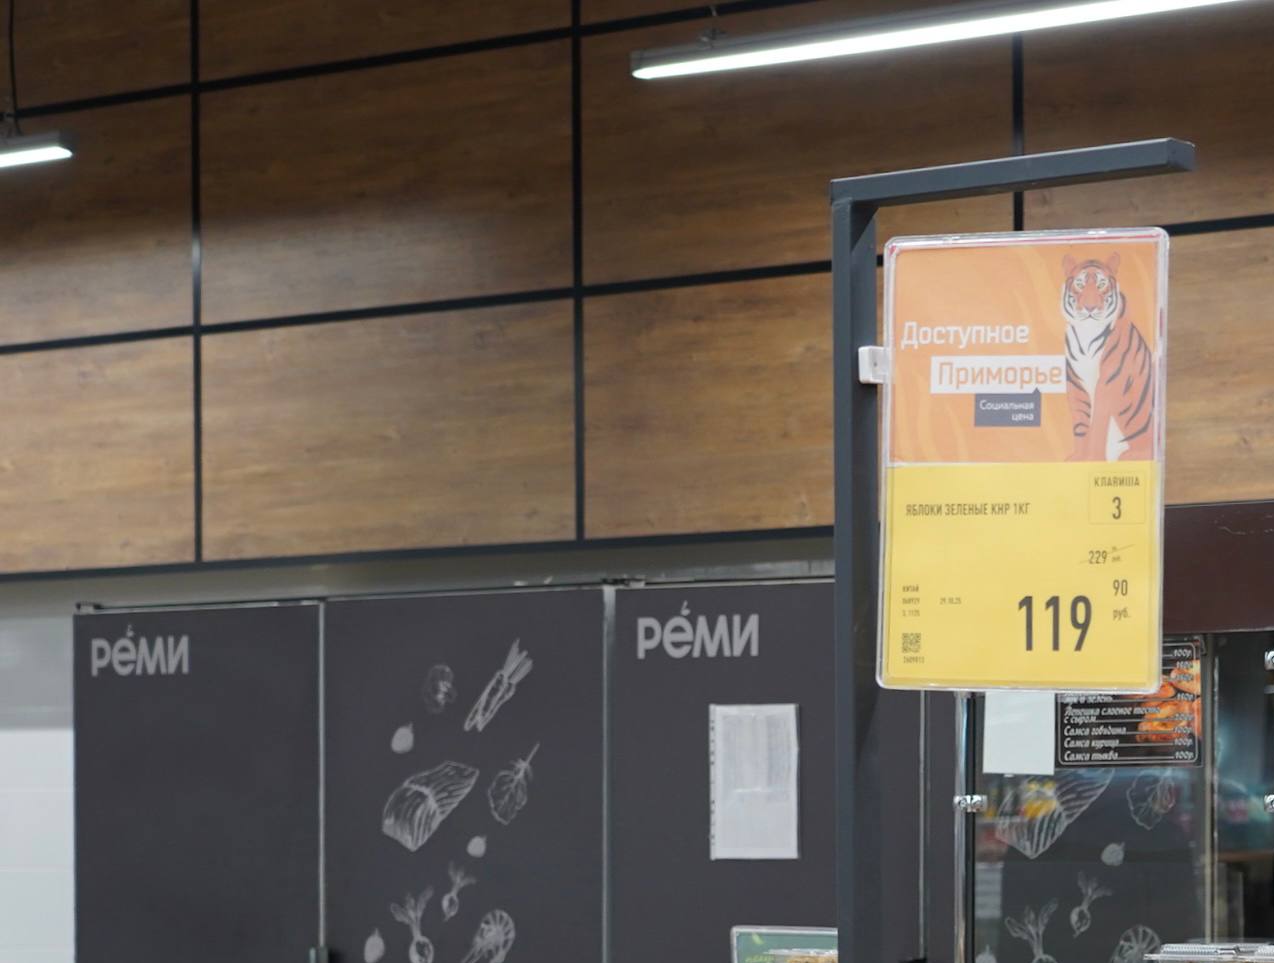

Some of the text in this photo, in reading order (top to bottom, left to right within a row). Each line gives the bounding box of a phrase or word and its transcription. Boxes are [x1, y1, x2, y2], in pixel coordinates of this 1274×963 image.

[901, 321, 1030, 350] Доступное
[938, 362, 1063, 390] Приморье
[979, 400, 1035, 411] Социальная
[1011, 413, 1035, 422] цена
[1094, 476, 1140, 487] КЛАВИША
[905, 504, 942, 516] ЯБЛОКИ
[945, 503, 989, 516] ЗЕЛЕНЫЕ
[991, 502, 1010, 515] КНР
[1112, 496, 1122, 520] 3
[1112, 579, 1128, 597] 90
[1018, 595, 1093, 652] 119
[1064, 725, 1090, 736] Самса
[1064, 737, 1090, 748] Самса
[1064, 750, 1090, 761] Самса
